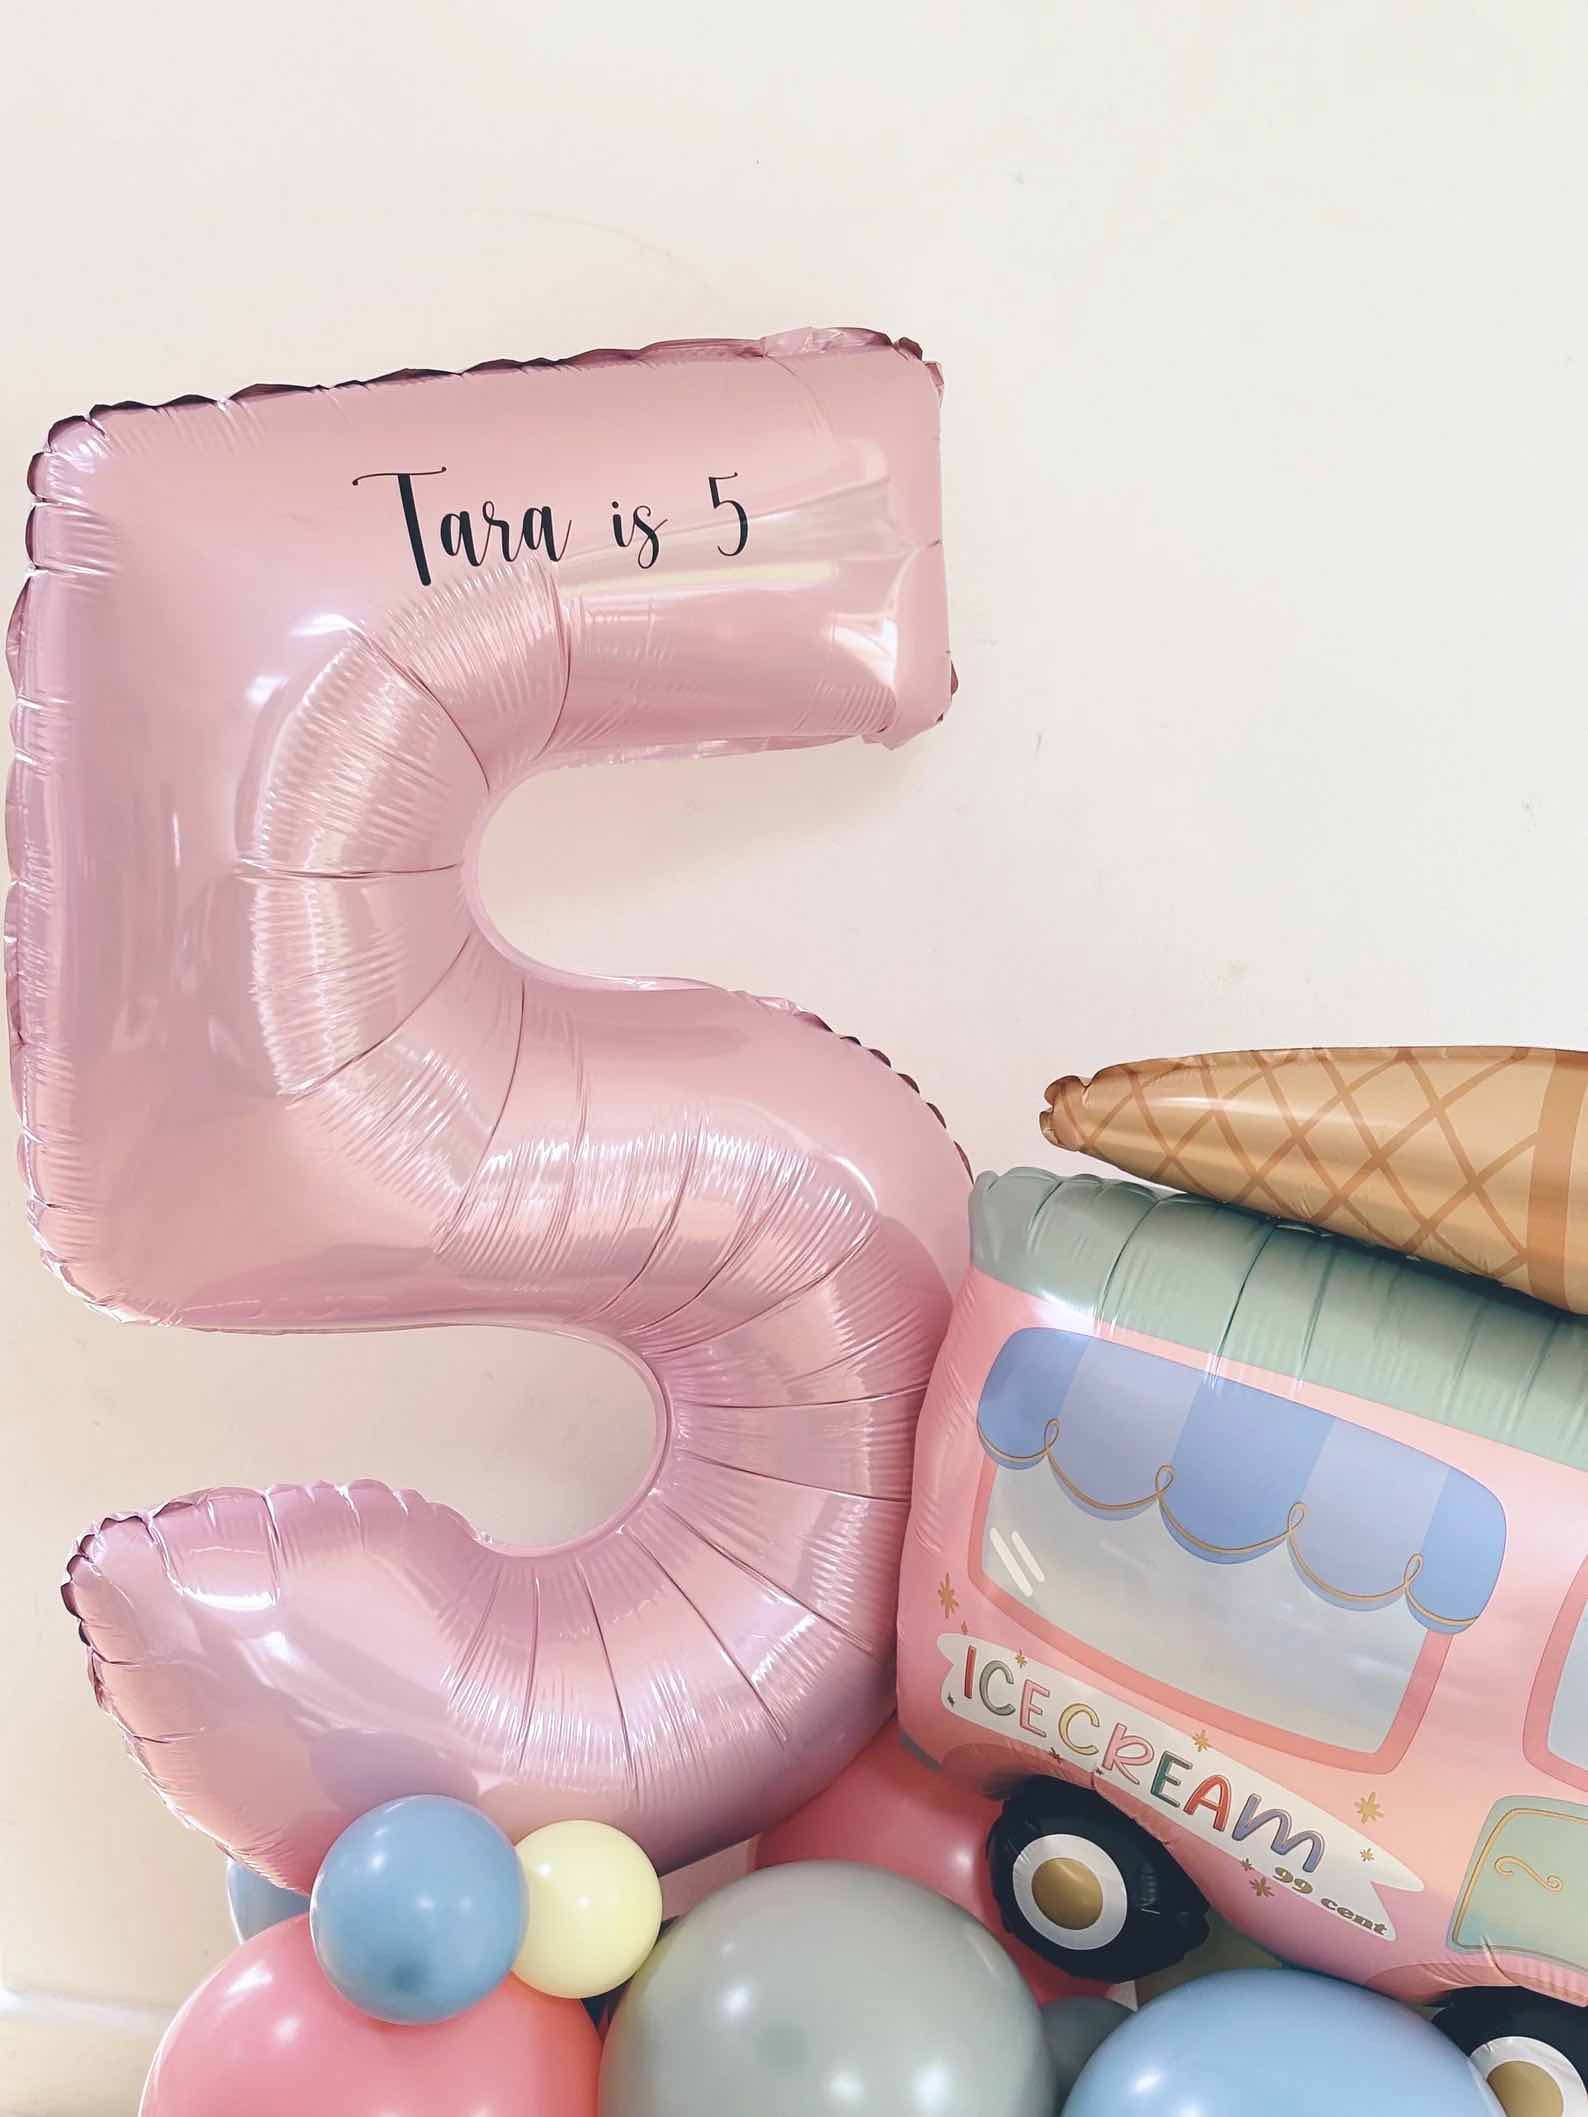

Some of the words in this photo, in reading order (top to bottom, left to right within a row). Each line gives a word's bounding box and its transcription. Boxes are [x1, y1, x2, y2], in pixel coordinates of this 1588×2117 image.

[352, 466, 572, 586] Tara
[611, 501, 669, 569] is
[708, 472, 749, 557] 5
[1272, 1866, 1313, 1894] 99
[1320, 1898, 1387, 1936] cent
